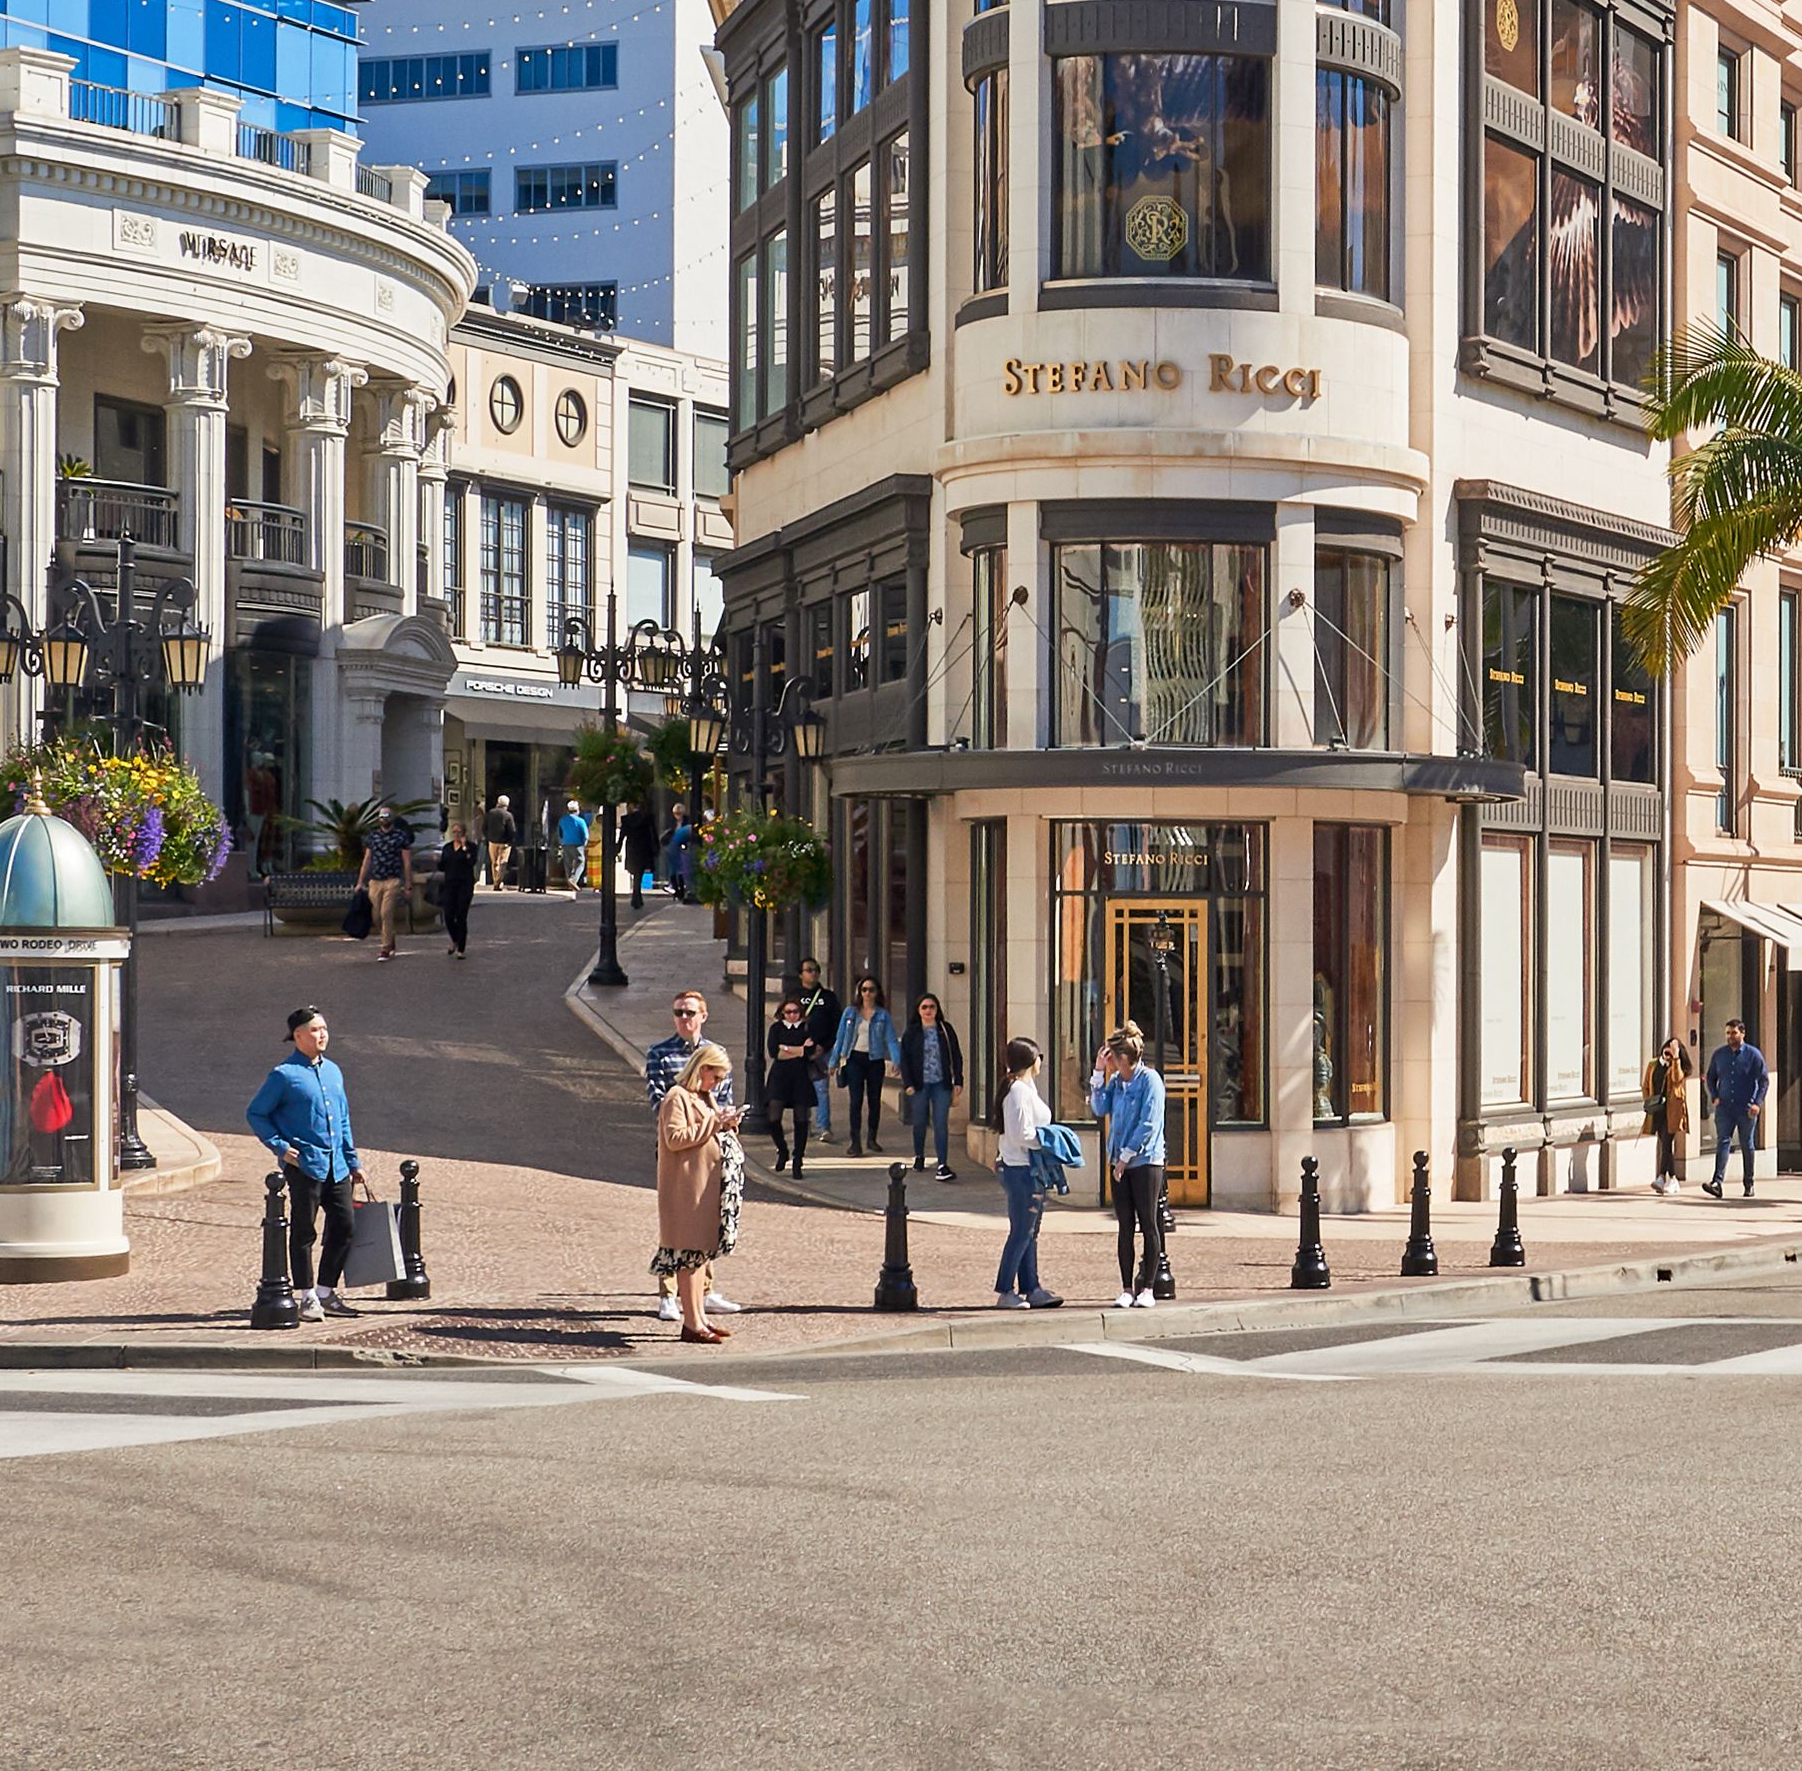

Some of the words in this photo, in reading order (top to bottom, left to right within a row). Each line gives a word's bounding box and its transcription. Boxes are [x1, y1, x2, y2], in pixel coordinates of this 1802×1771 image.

[465, 679, 515, 694] PORSCHE
[516, 685, 553, 698] DESIGN
[22, 939, 62, 949] RODEO
[68, 939, 98, 950] DRIVE
[6, 985, 53, 993] RICHARD
[56, 985, 86, 994] MILLE
